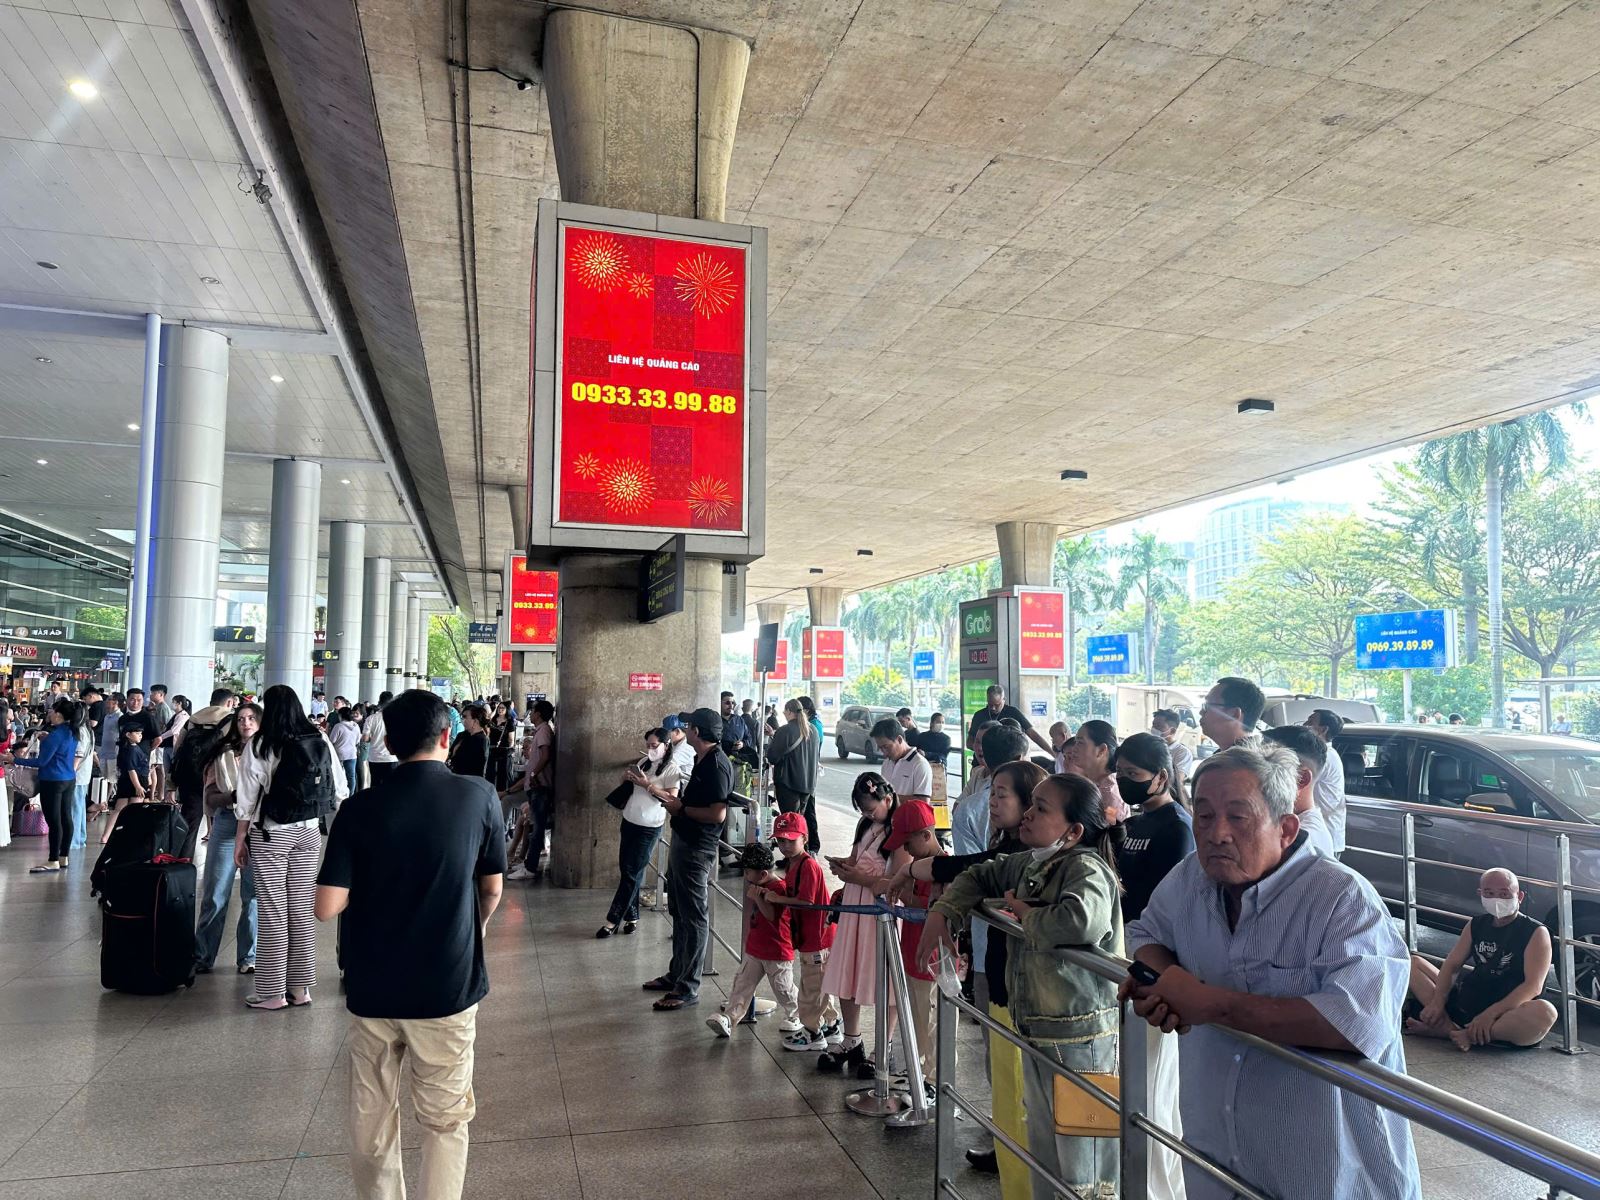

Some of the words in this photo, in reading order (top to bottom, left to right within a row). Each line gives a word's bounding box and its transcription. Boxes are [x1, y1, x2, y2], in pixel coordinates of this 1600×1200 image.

[608, 354, 630, 365] LIÊN
[632, 356, 645, 368] HỆ
[646, 358, 679, 370] QUẢNG
[681, 361, 700, 371] CÁO
[571, 382, 737, 414] 0933.33.99.88
[965, 610, 991, 635] Grab
[233, 627, 243, 640] 7
[1366, 639, 1434, 653] 0969.39.89.89
[324, 650, 332, 660] 6
[367, 661, 374, 669] 5
